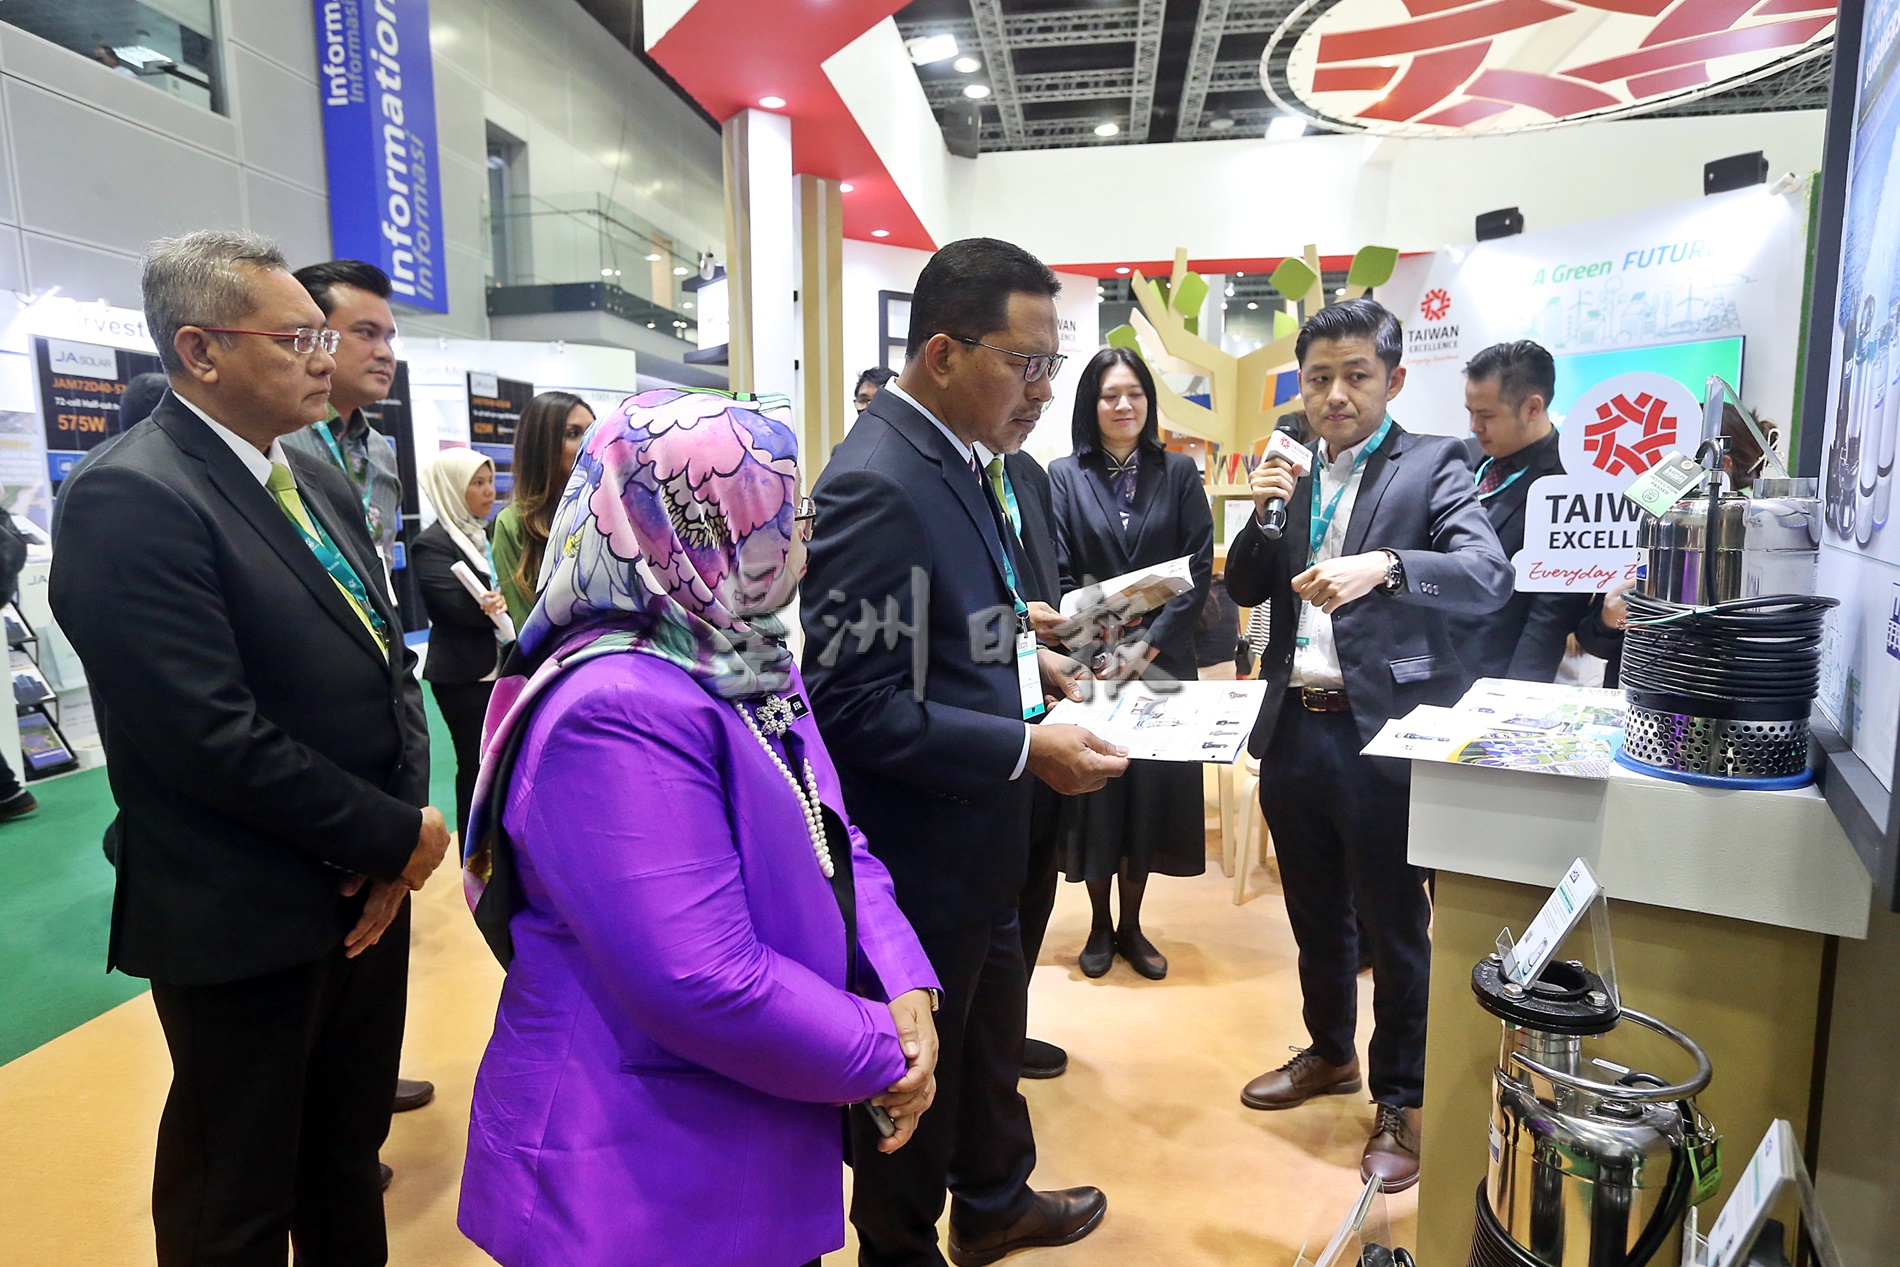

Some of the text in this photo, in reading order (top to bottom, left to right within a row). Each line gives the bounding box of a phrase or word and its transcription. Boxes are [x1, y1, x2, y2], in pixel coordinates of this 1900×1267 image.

[323, 0, 348, 106] Inform
[405, 130, 434, 300] Informasi
[1532, 268, 1546, 287] A
[1552, 259, 1613, 284] Green
[1407, 324, 1460, 343] TAIWAN
[1408, 340, 1458, 354] EXCELLENCE
[57, 413, 106, 433] 575W
[1649, 474, 1678, 496] INSPECTION
[1650, 481, 1670, 496] PASSED
[1549, 530, 1640, 550] EXCELL
[1528, 561, 1618, 589] Everyday
